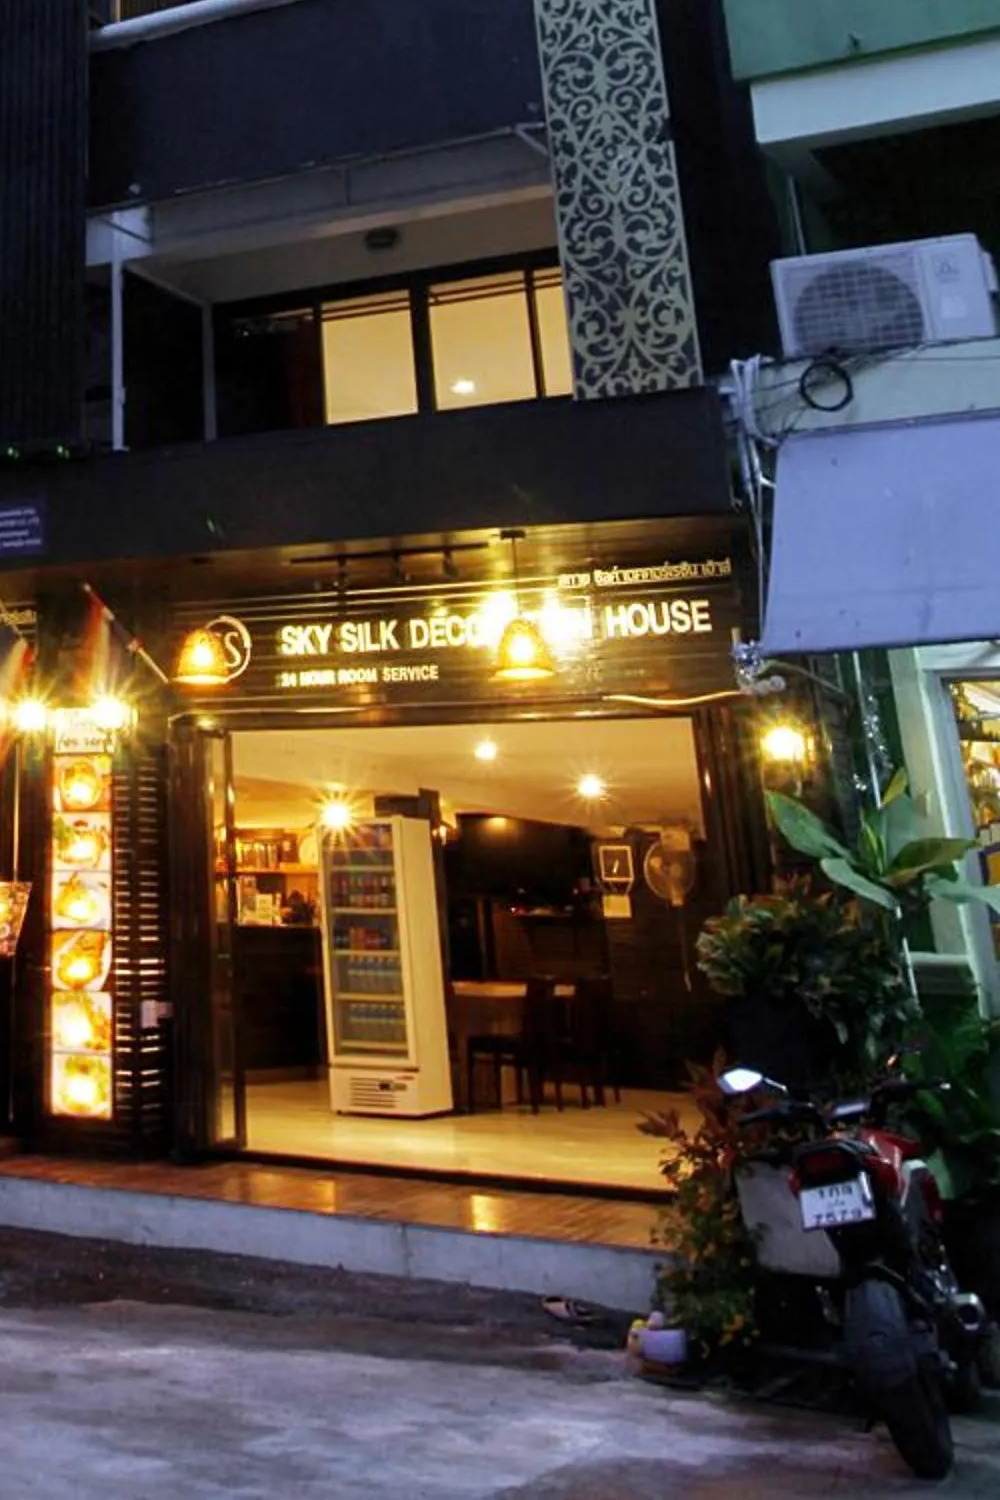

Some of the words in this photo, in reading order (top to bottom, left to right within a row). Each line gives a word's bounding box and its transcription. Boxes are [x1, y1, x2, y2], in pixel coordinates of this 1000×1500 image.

[280, 622, 333, 656] SKY
[340, 618, 400, 654] SILK
[606, 599, 713, 638] HOUSE
[337, 666, 379, 684] ROOM
[381, 663, 440, 682] SERVICE
